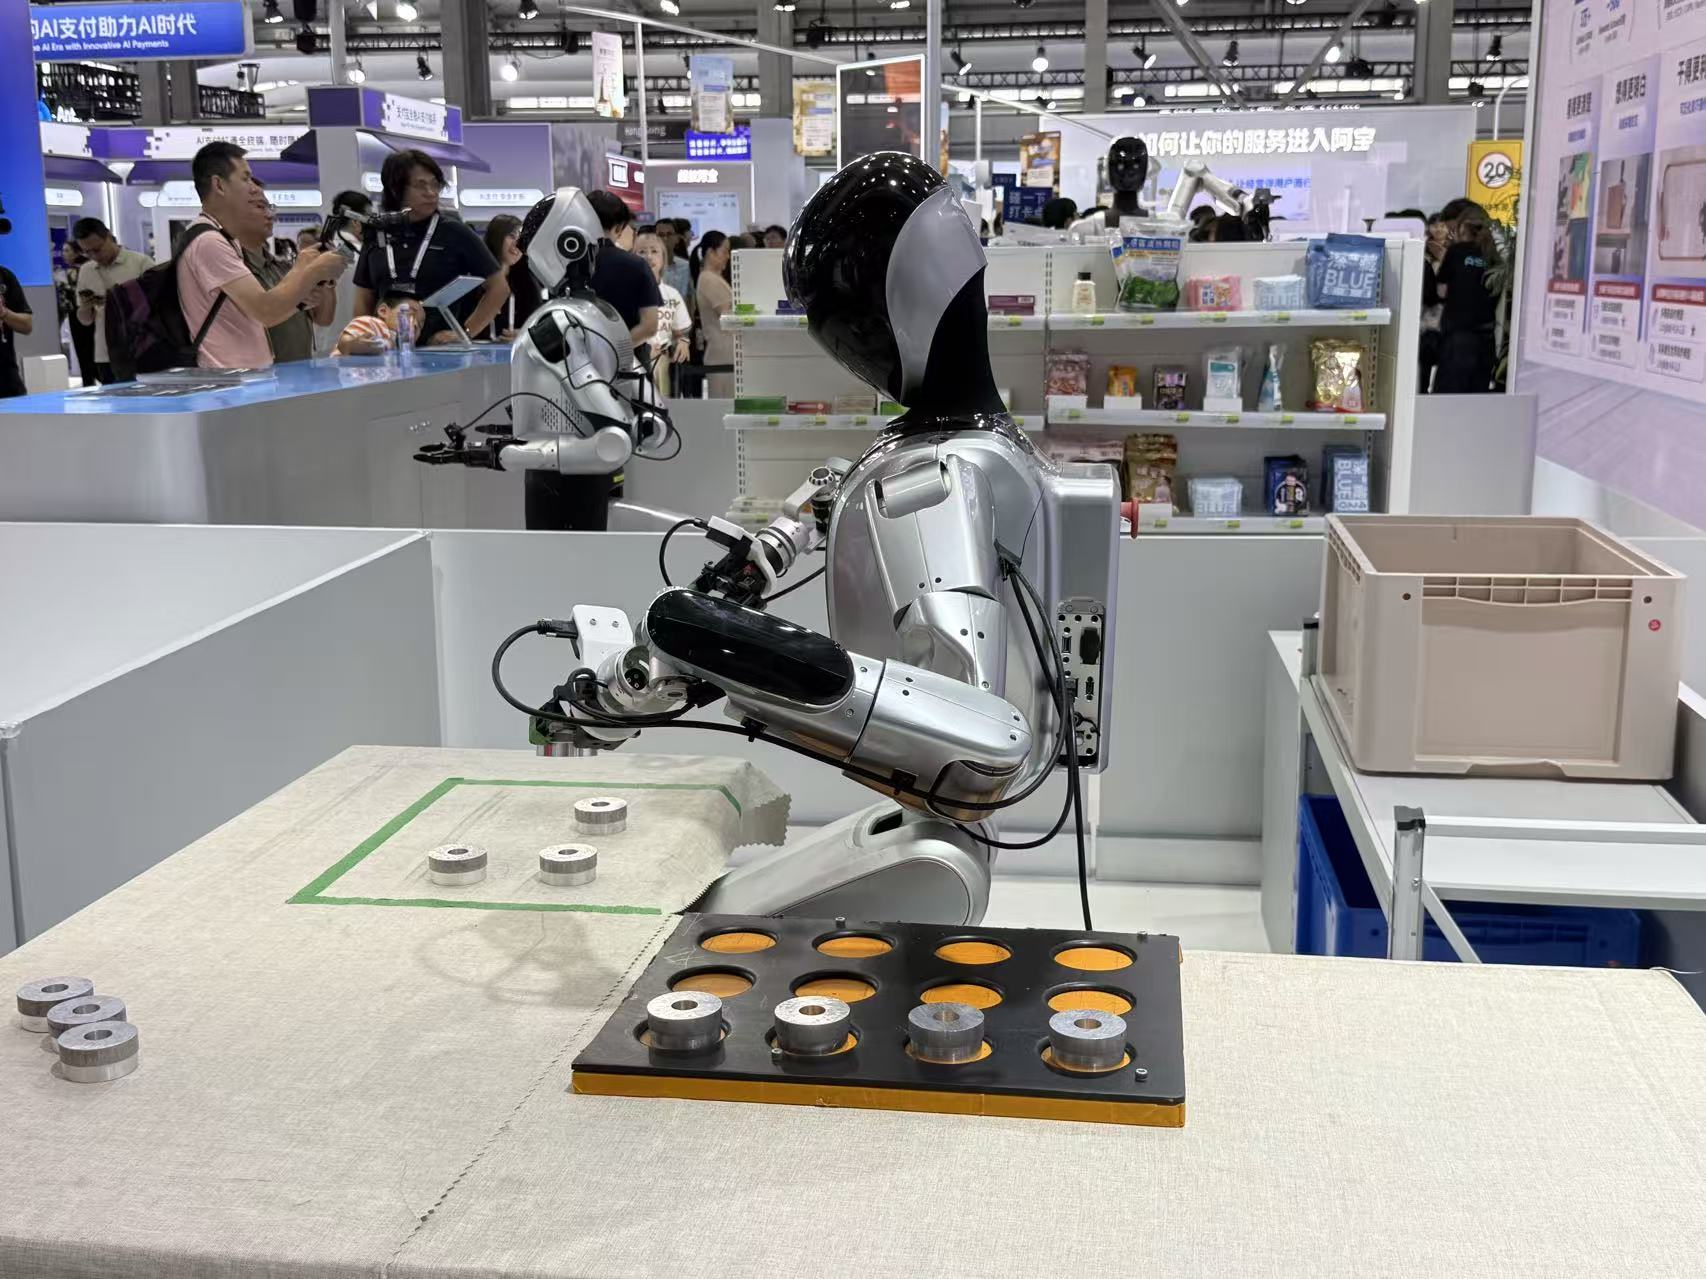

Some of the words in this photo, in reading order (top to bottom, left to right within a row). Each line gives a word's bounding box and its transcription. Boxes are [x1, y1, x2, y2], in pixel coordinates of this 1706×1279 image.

[52, 43, 64, 51] Era
[66, 42, 82, 50] with
[83, 40, 121, 50] Innovative
[133, 39, 169, 49] Payments
[1324, 269, 1375, 290] BLUE
[1337, 459, 1352, 500] BLUE
